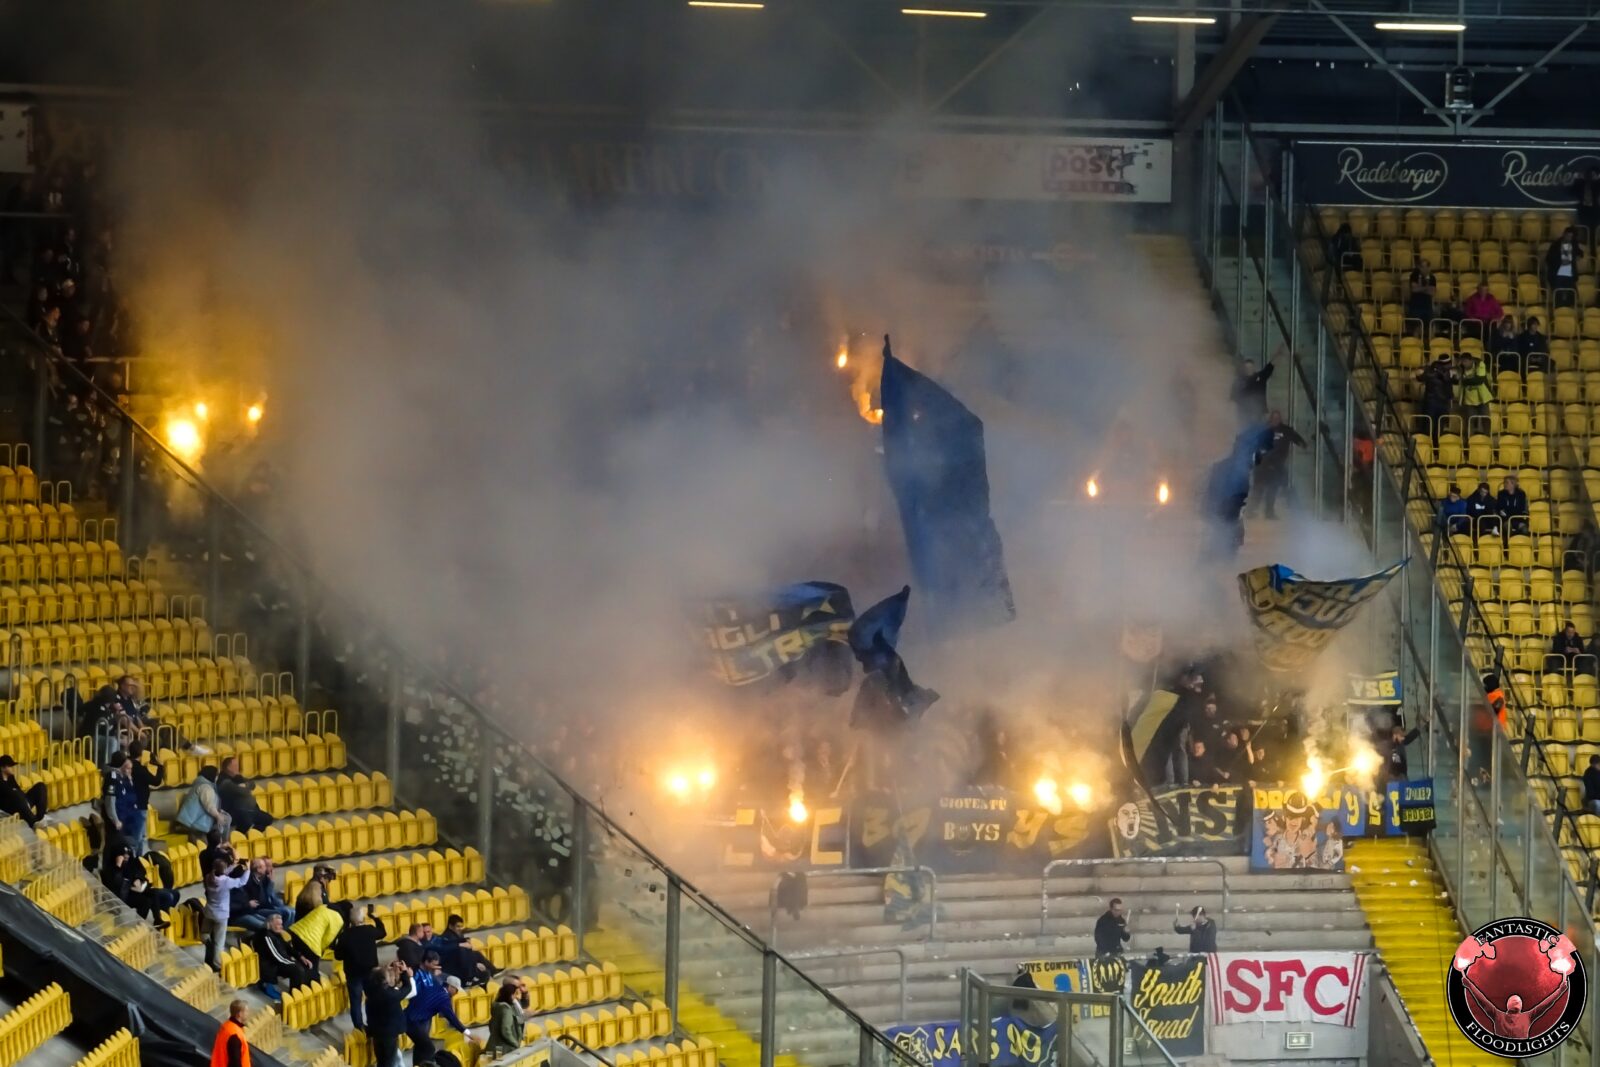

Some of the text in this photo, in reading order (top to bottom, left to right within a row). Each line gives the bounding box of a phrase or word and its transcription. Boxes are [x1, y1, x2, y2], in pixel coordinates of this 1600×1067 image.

[1338, 148, 1443, 194] Radeberger
[1018, 961, 1042, 974] OYS
[1133, 961, 1203, 1009] Youth
[1223, 958, 1350, 1016] SFC
